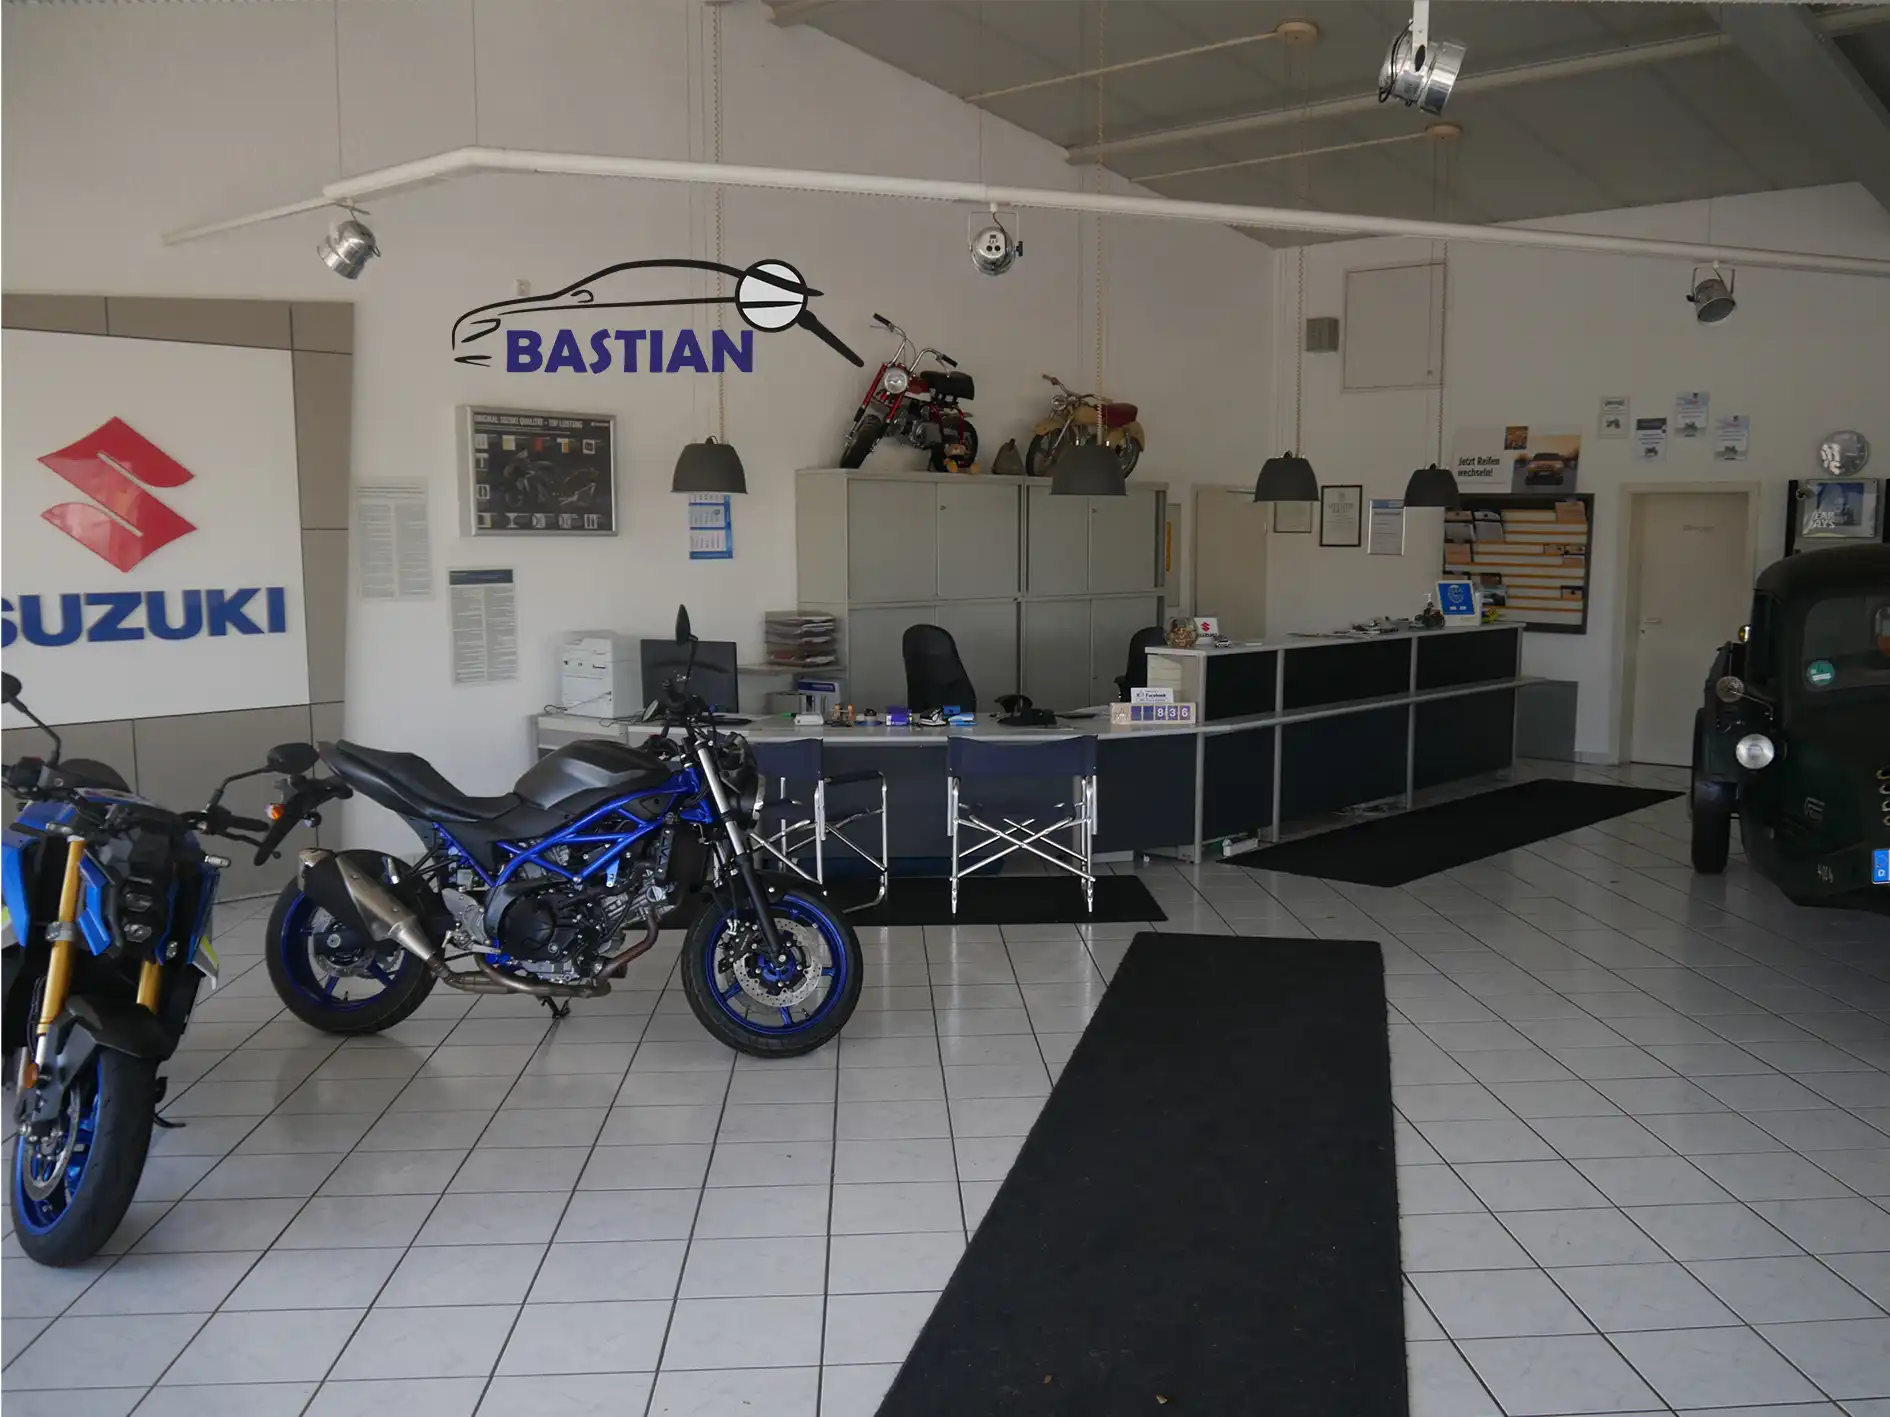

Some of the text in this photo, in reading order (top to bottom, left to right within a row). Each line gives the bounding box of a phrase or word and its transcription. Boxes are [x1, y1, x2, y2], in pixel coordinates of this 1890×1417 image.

[506, 329, 753, 374] BASTIAN
[1458, 456, 1500, 466] Jetzt Reifen
[1458, 468, 1493, 477] wechseln!
[1878, 869, 1886, 877] D
